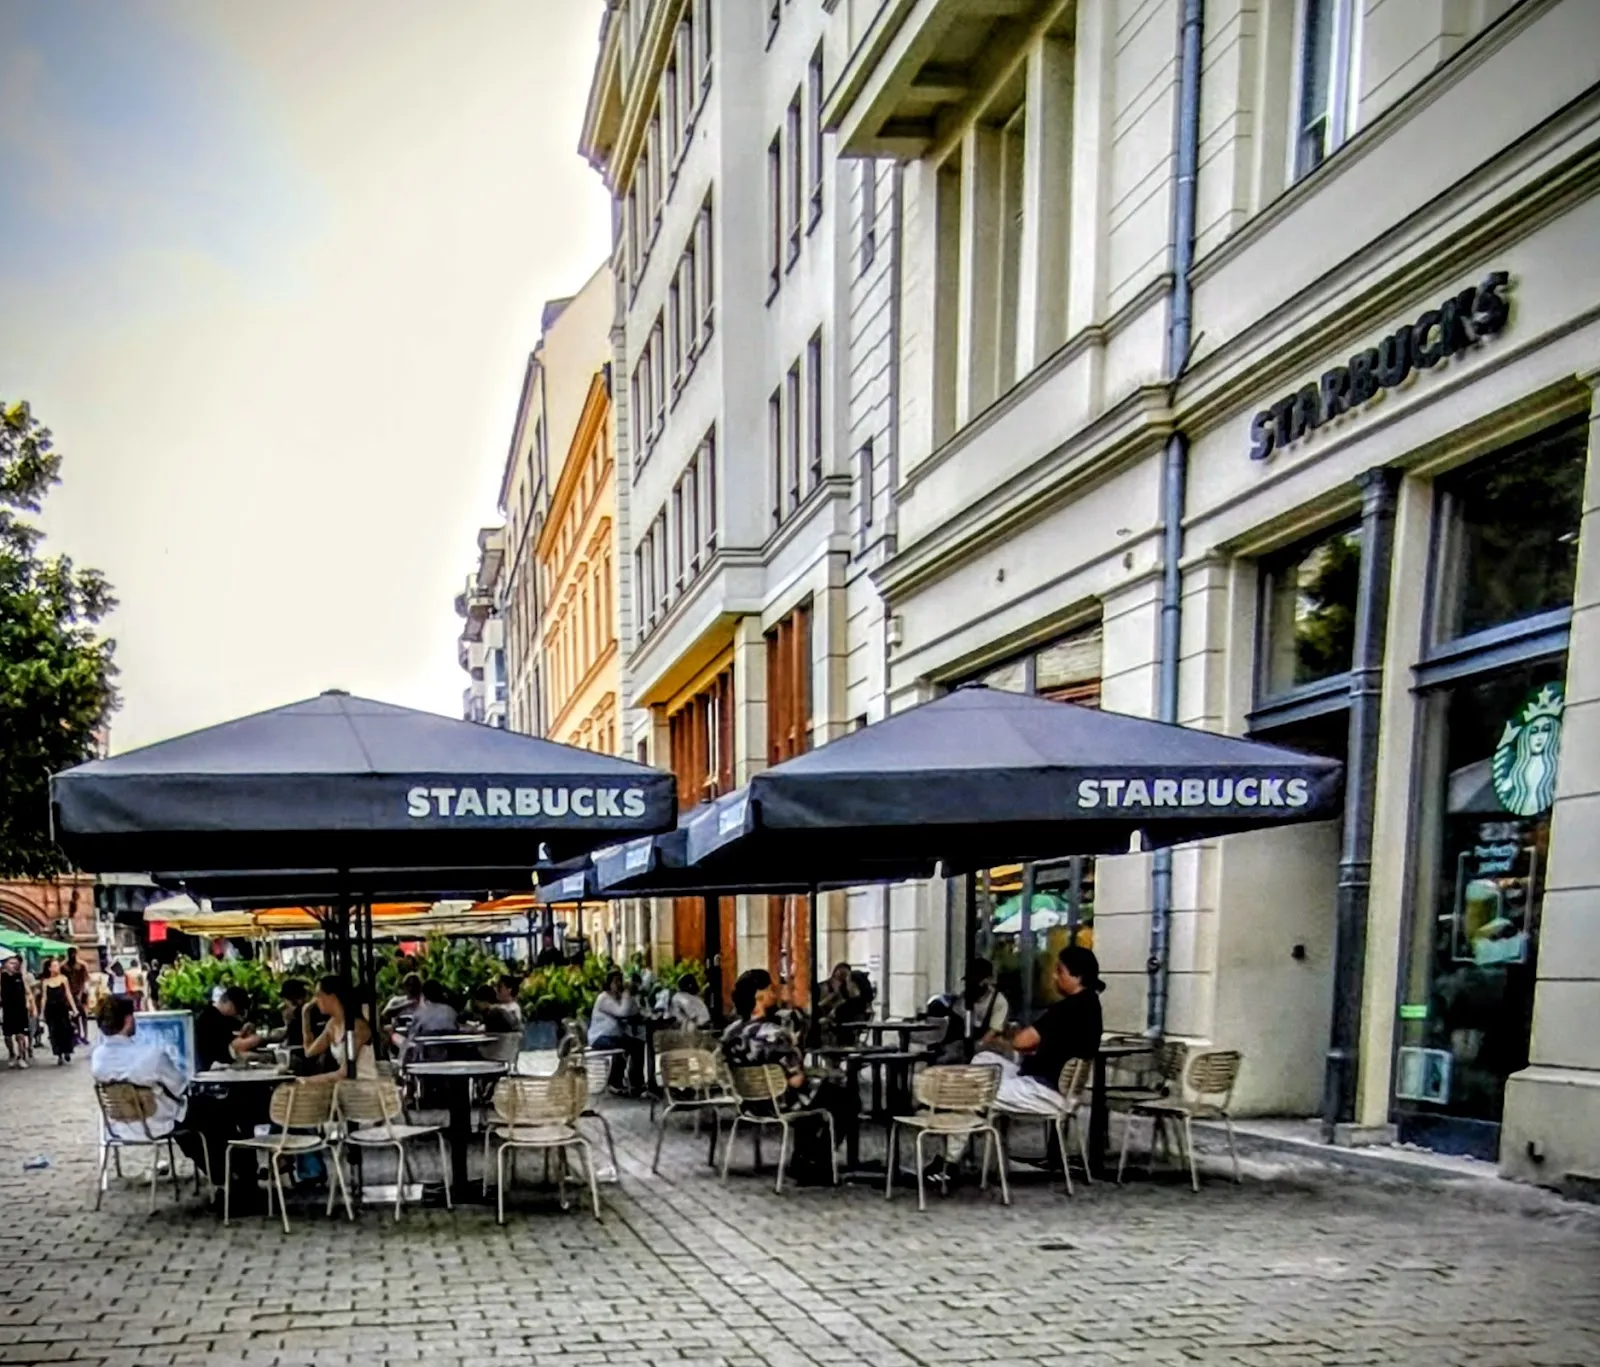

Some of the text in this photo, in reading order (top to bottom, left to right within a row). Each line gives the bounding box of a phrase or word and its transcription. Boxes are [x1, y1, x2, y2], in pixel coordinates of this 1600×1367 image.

[1249, 270, 1510, 461] STARBUCKS
[407, 786, 646, 818] STARBUCKS
[1078, 777, 1309, 808] STARBUCKS
